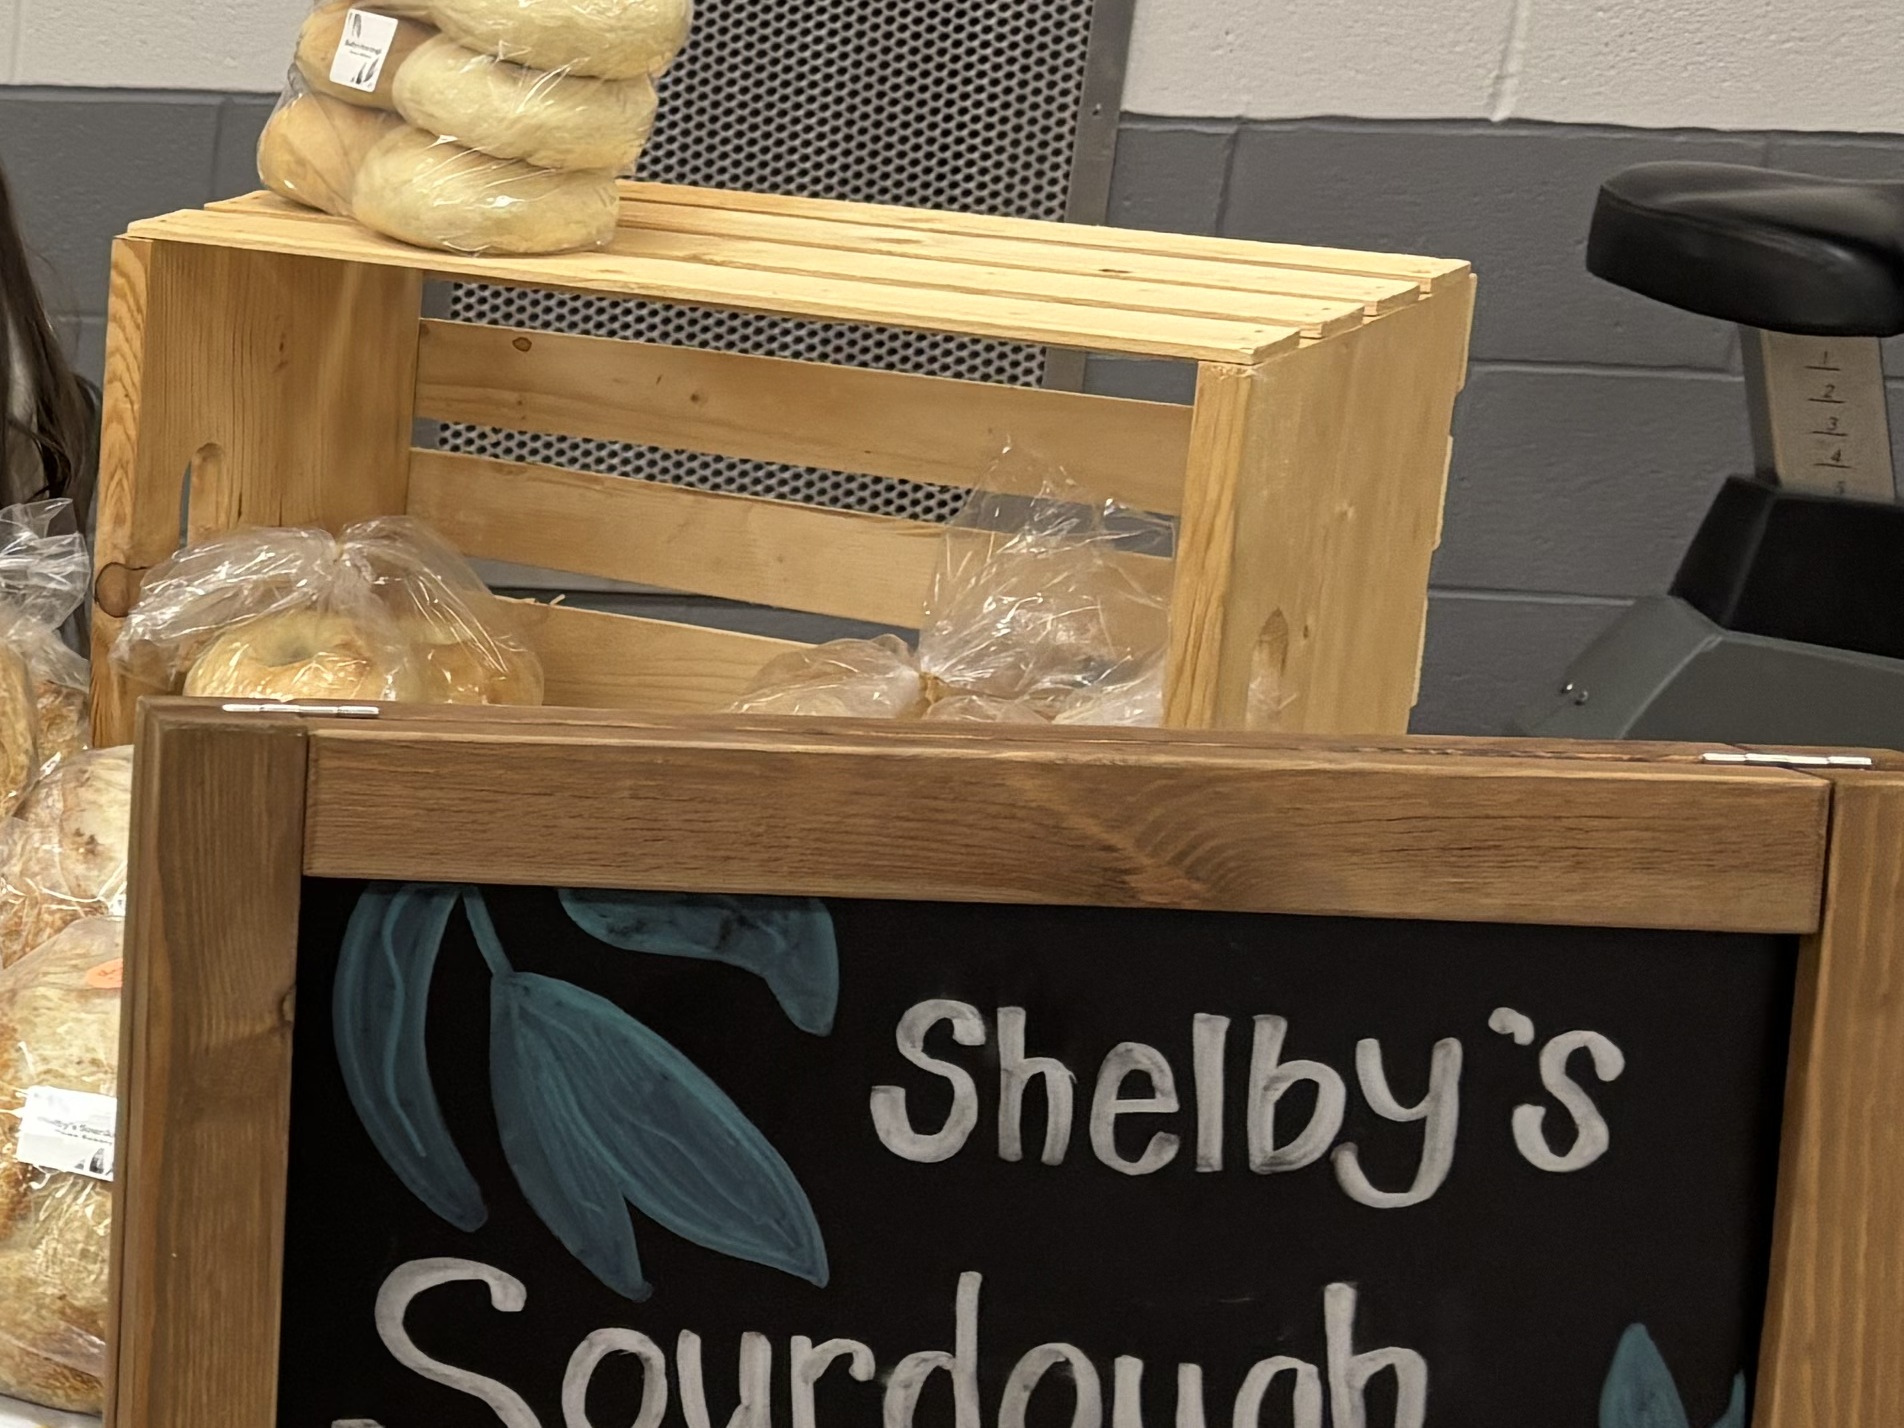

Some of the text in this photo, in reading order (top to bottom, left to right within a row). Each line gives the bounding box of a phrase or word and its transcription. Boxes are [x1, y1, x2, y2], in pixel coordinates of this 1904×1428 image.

[1822, 384, 1836, 399] 2
[1826, 416, 1839, 431] 3
[1830, 448, 1842, 463] 4
[870, 996, 1626, 1210] Shelby's
